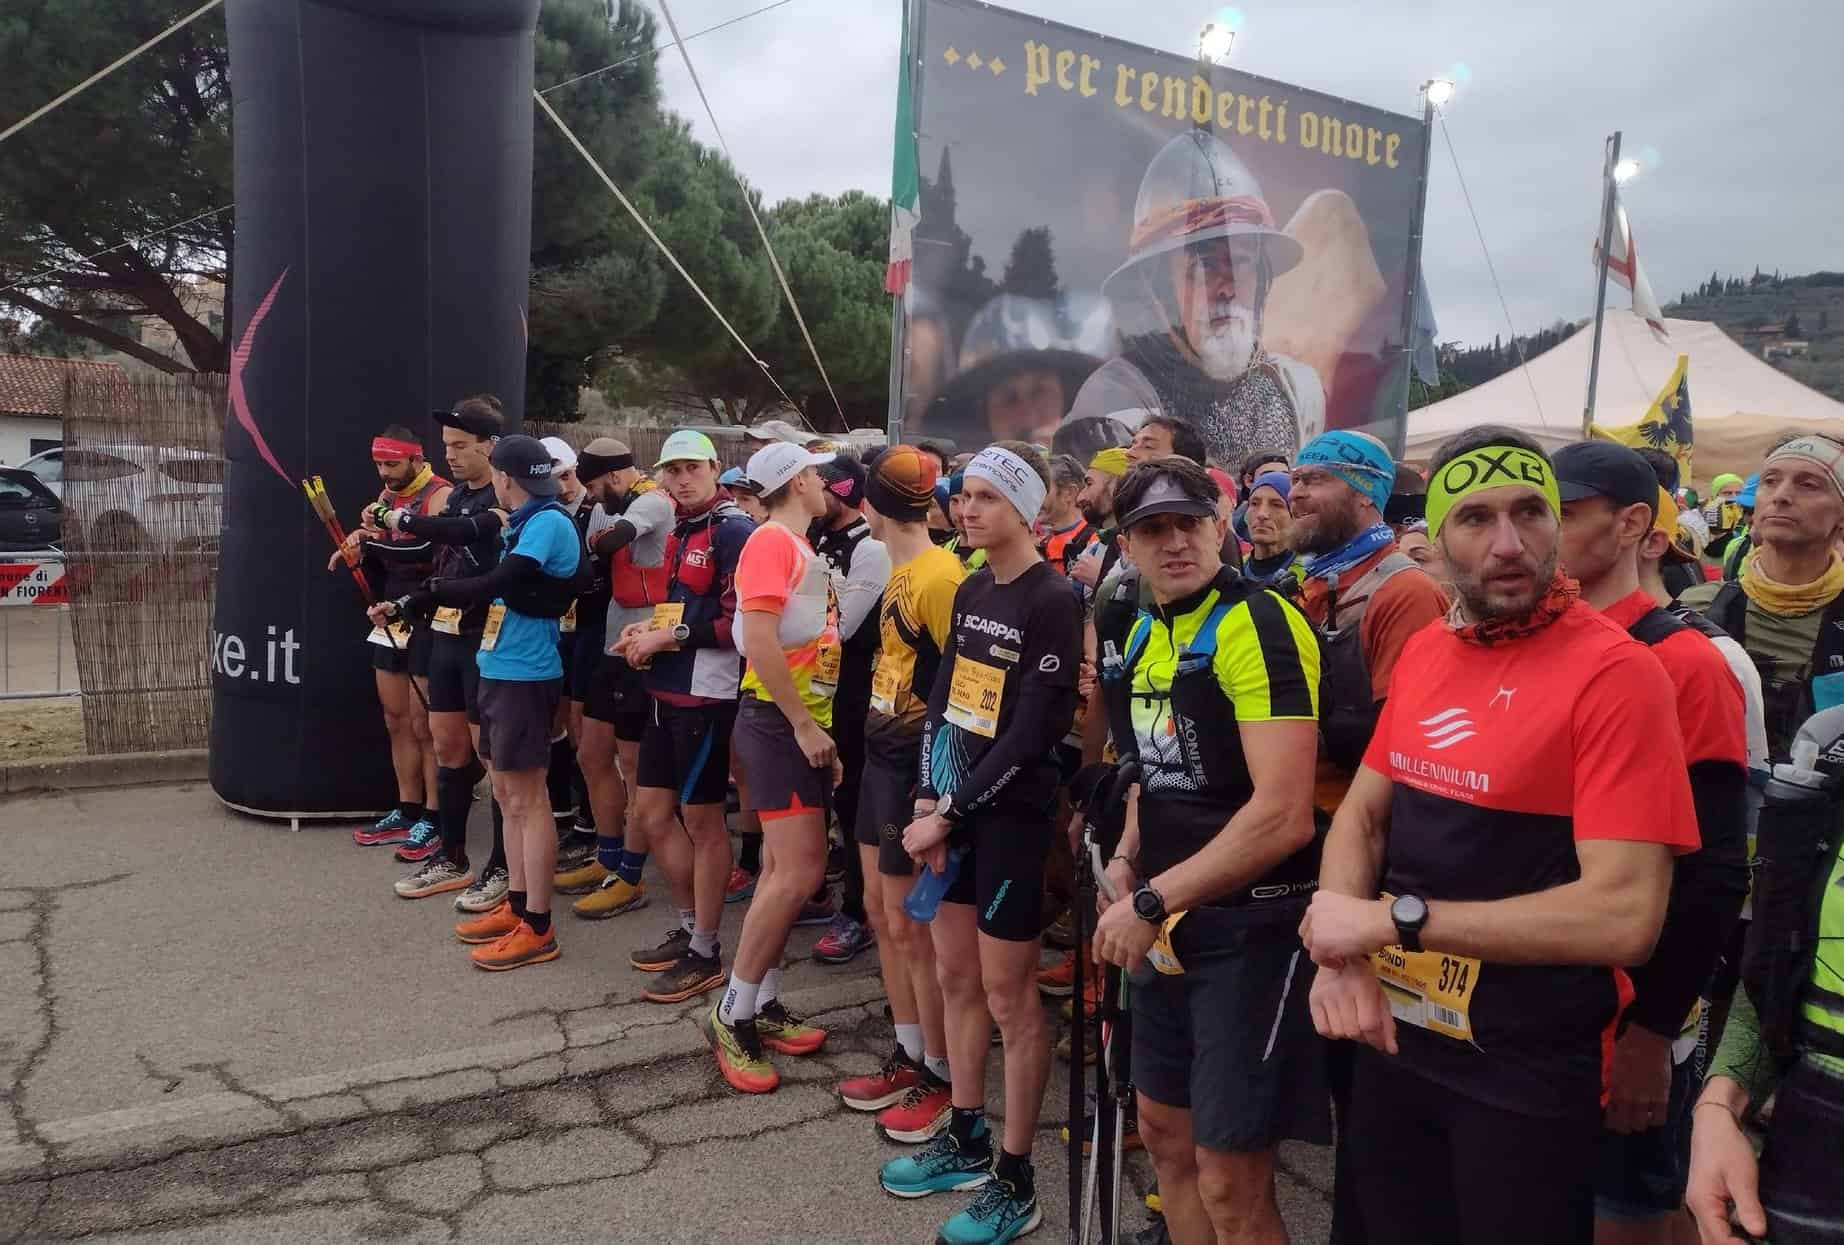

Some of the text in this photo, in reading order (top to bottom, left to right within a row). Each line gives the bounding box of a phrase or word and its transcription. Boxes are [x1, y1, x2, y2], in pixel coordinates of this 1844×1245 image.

[1023, 39, 1100, 98] per
[1114, 63, 1289, 144] renderti
[1300, 110, 1401, 169] onore
[36, 569, 48, 582] di
[963, 613, 1022, 645] SCARPA
[980, 687, 998, 712] 202
[921, 734, 932, 788] SCARPA
[1389, 751, 1489, 793] MILLENNIUM
[976, 764, 1021, 803] SCARPA
[1438, 956, 1470, 998] 374
